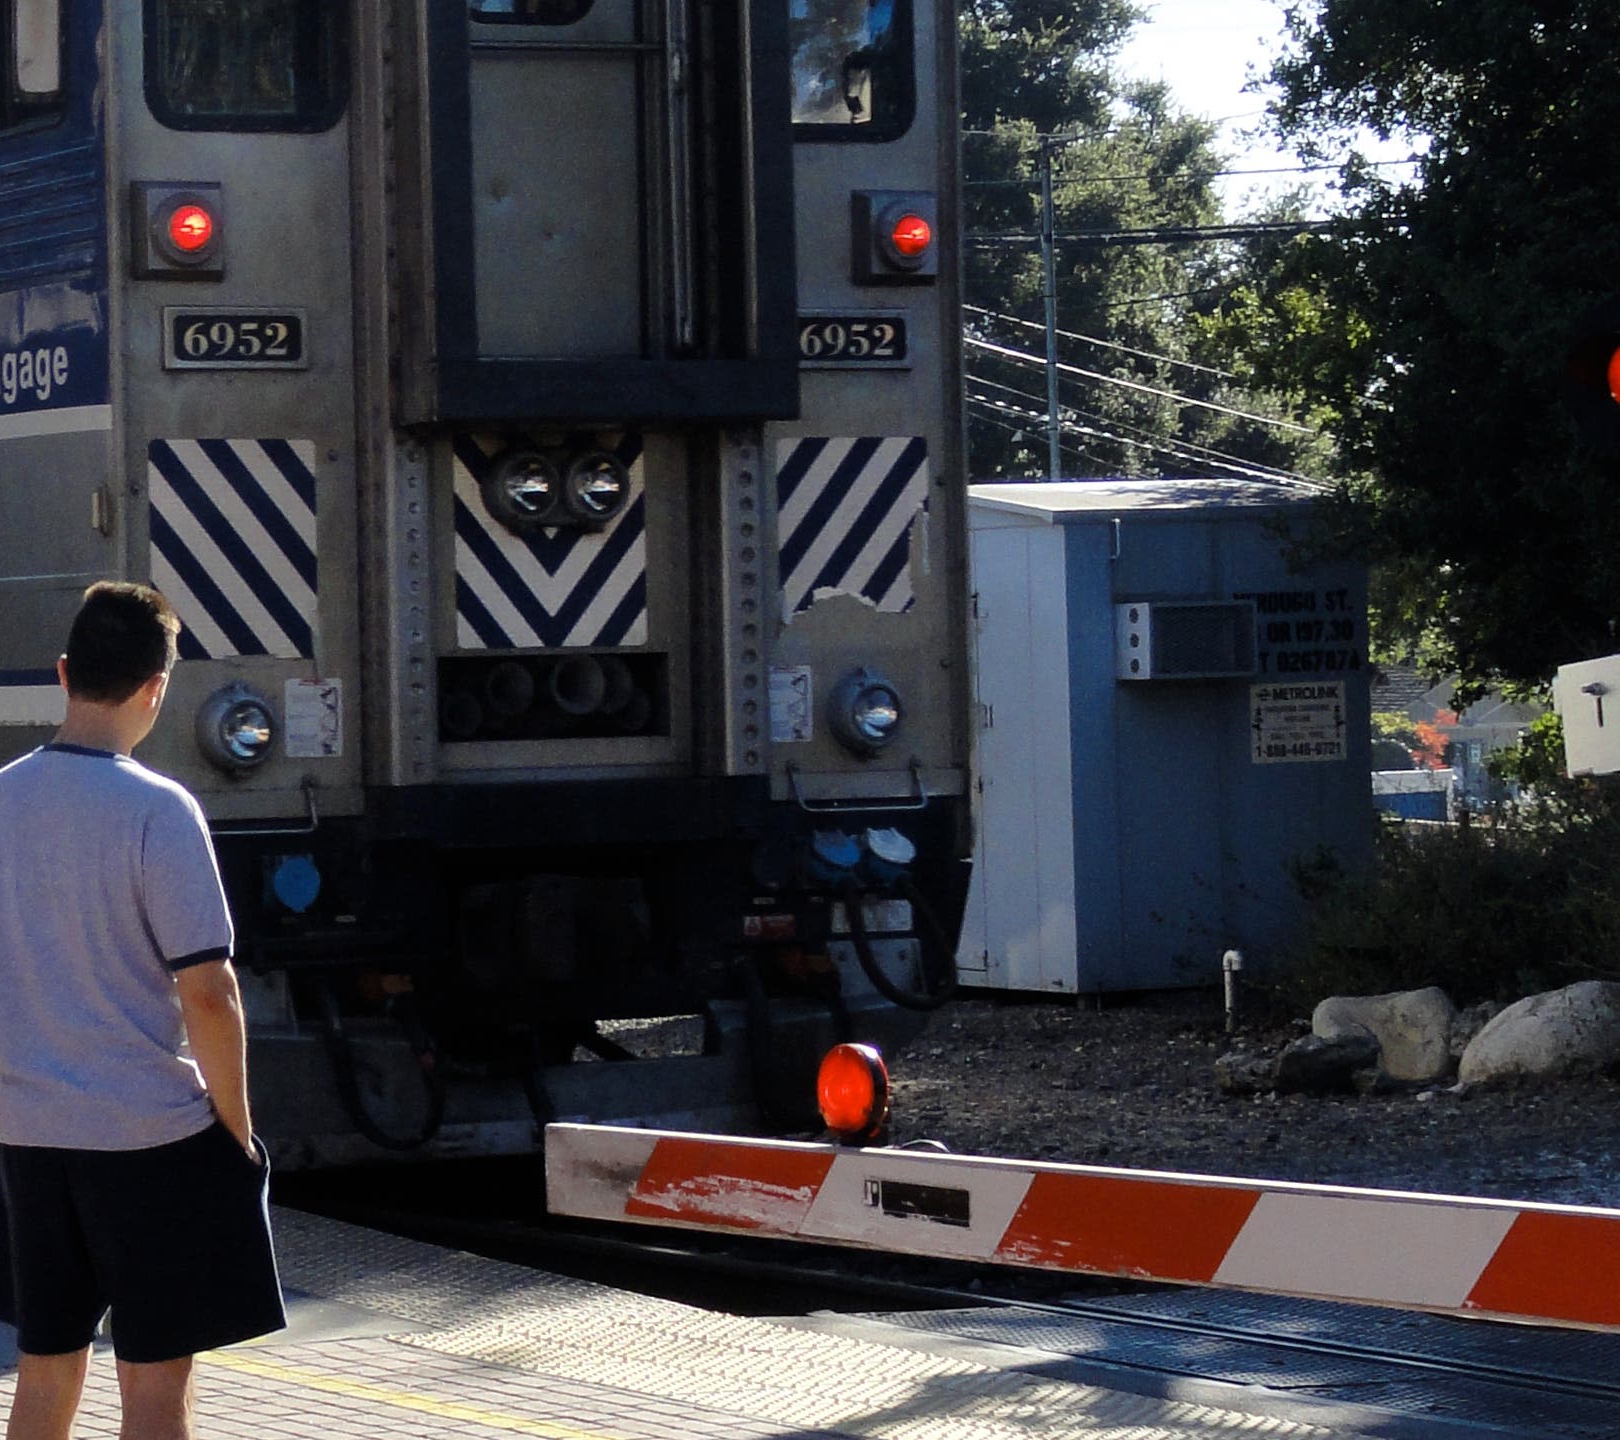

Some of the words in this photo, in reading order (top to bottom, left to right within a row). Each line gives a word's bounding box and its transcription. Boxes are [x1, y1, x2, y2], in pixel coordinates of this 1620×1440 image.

[184, 322, 288, 357] 6952
[799, 323, 896, 357] 6952
[1273, 686, 1339, 701] METROLINK
